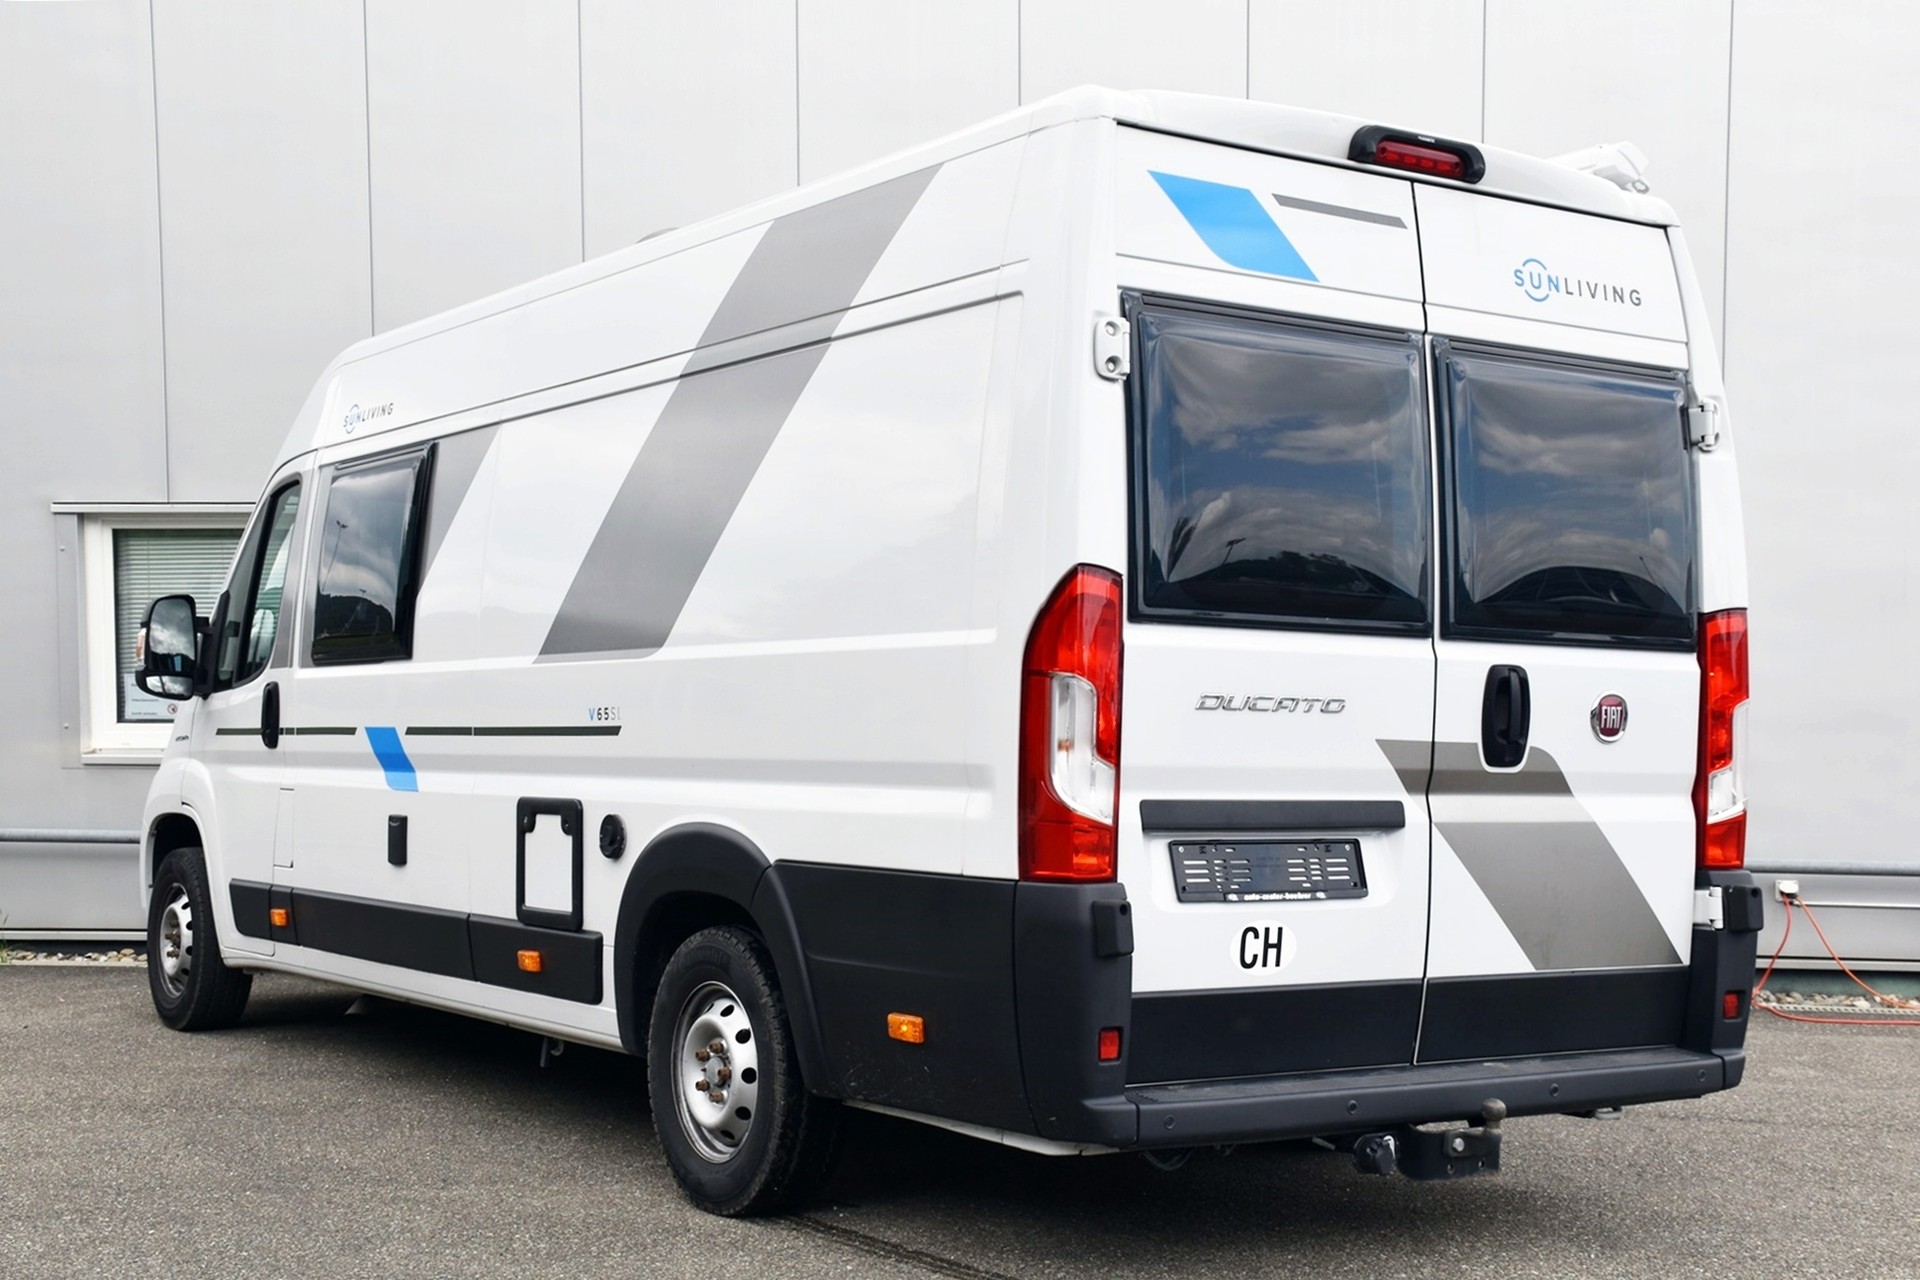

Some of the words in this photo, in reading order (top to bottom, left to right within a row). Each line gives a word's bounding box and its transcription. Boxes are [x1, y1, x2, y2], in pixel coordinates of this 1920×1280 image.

[1513, 263, 1642, 306] SUNLIVING
[343, 402, 394, 430] SUNLIVING
[1195, 693, 1346, 714] DUCATO
[1601, 706, 1622, 729] FIAT
[1239, 926, 1283, 969] CH
